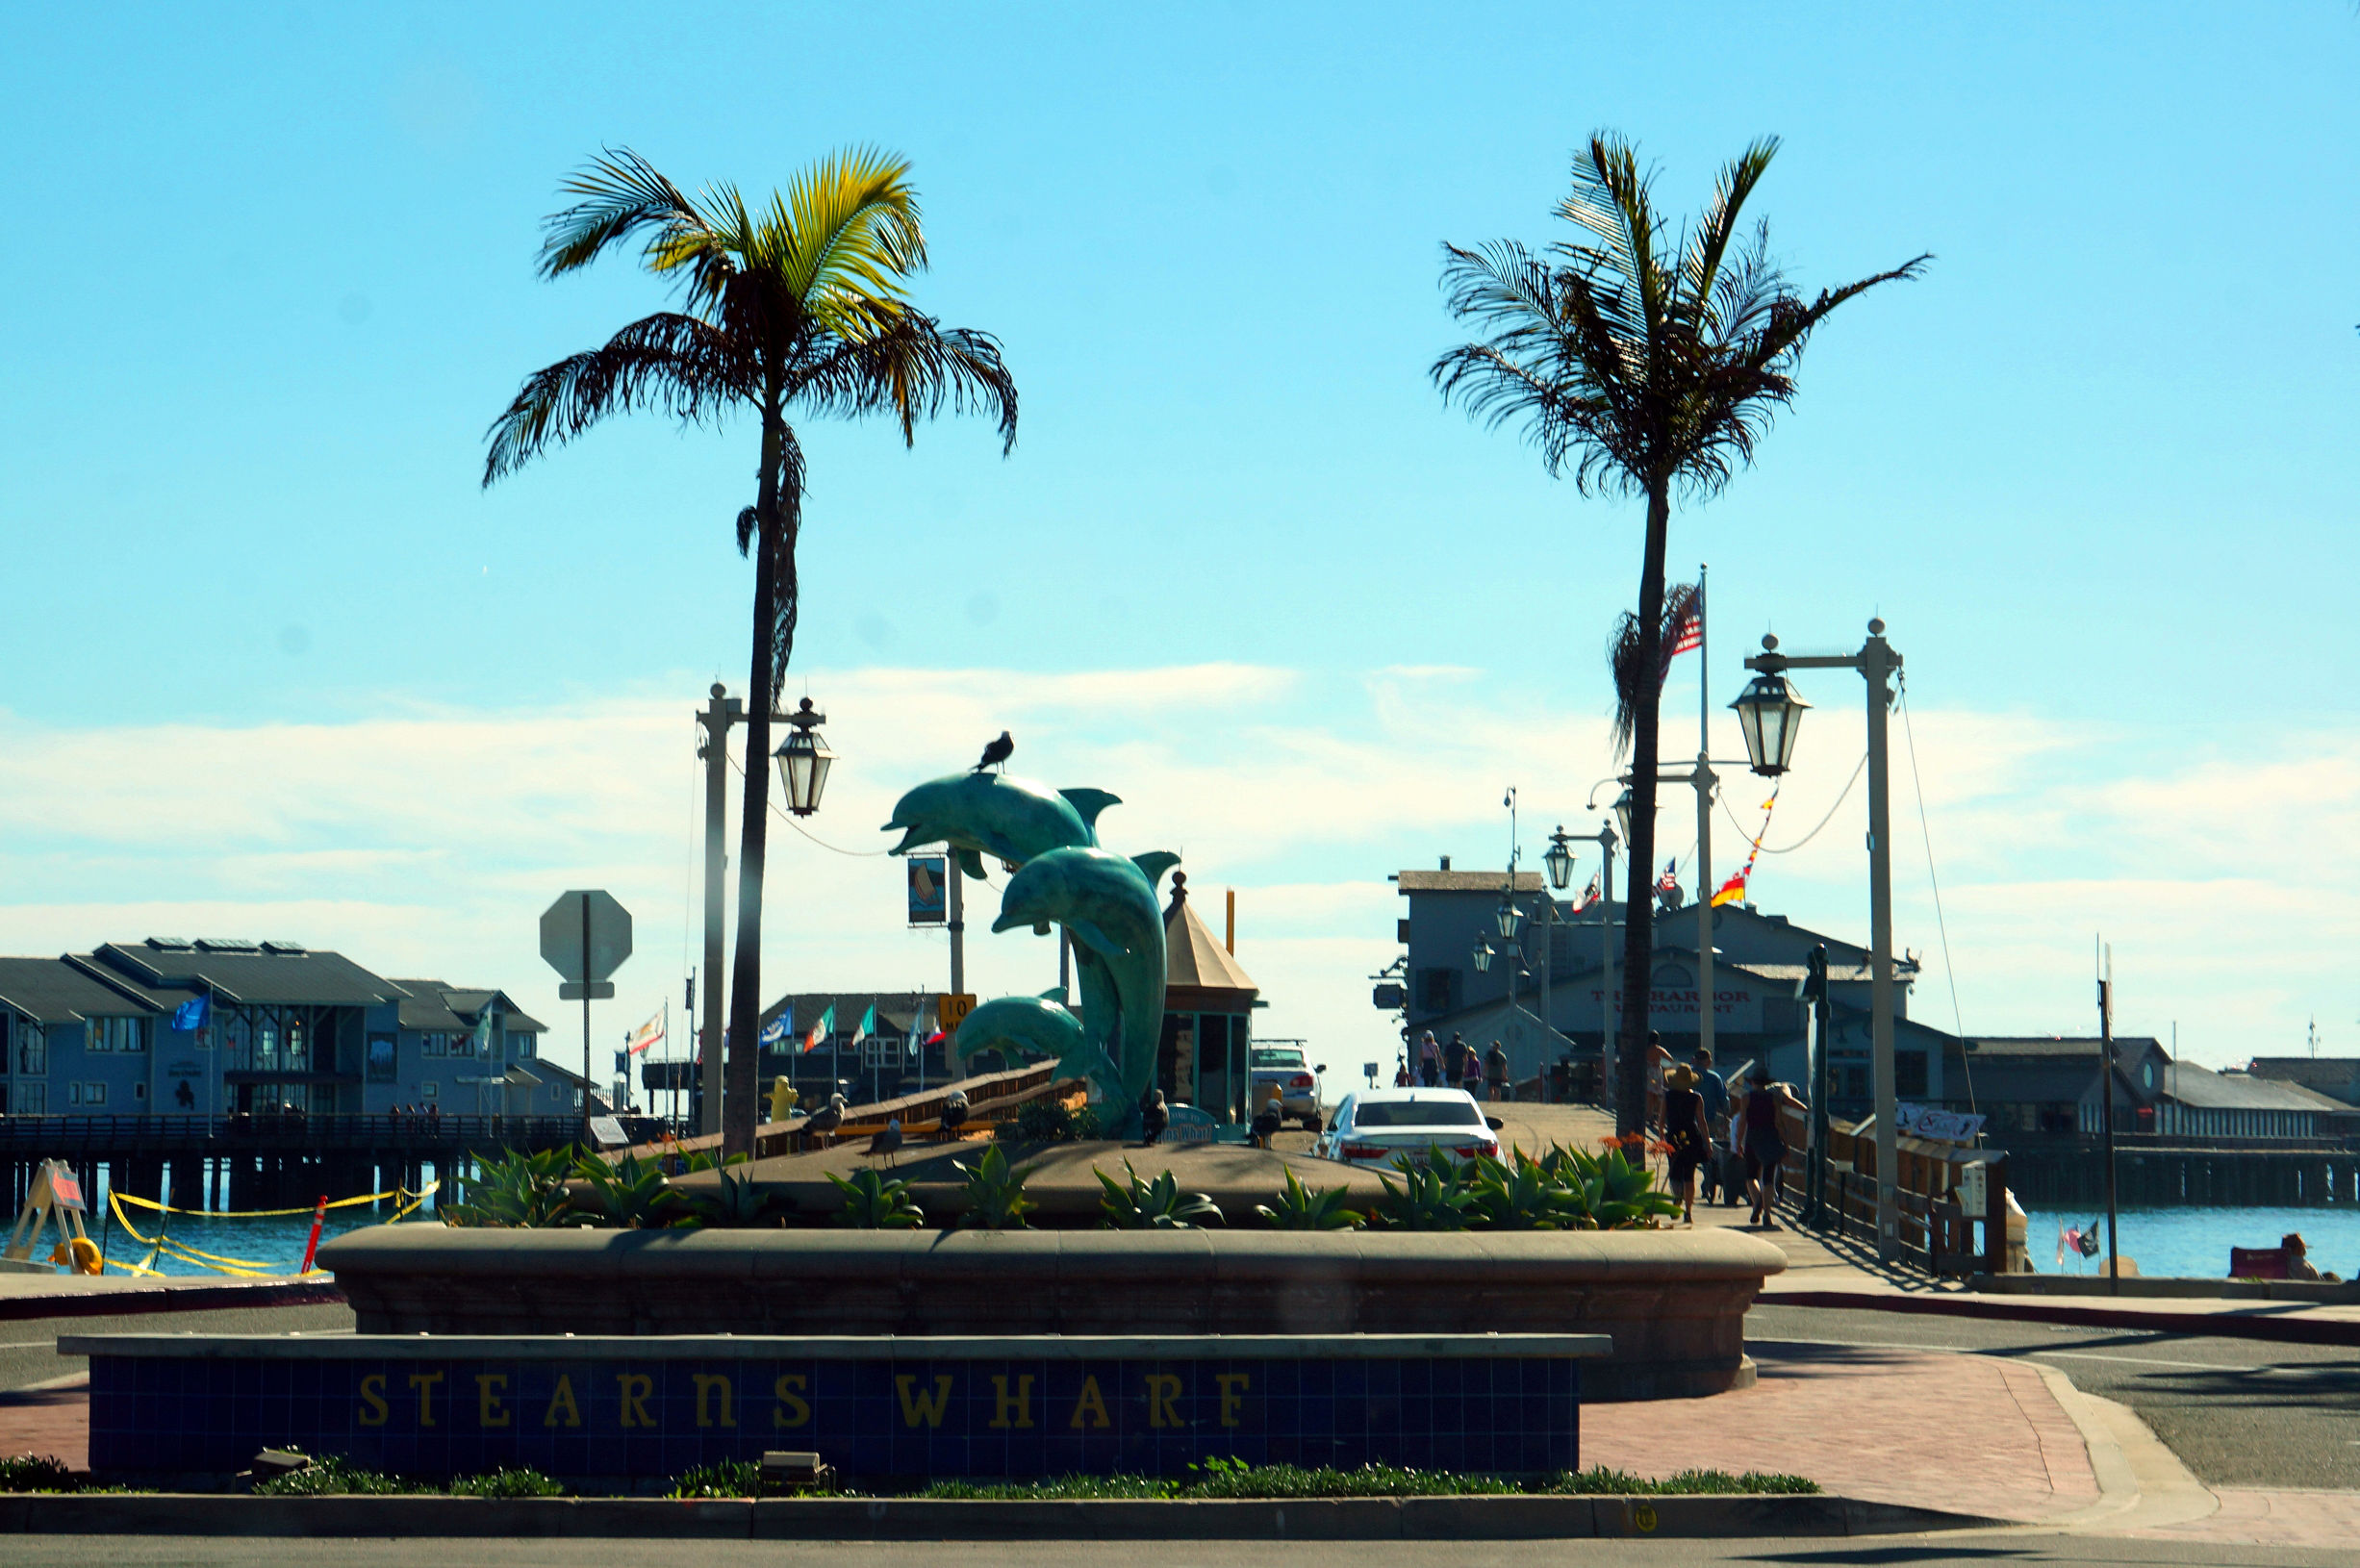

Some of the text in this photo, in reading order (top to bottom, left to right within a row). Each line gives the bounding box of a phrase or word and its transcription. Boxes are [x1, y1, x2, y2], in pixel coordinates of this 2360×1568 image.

[1650, 990, 1751, 1001] HAROR
[949, 999, 967, 1017] 10
[895, 1373, 1250, 1429] WHARF
